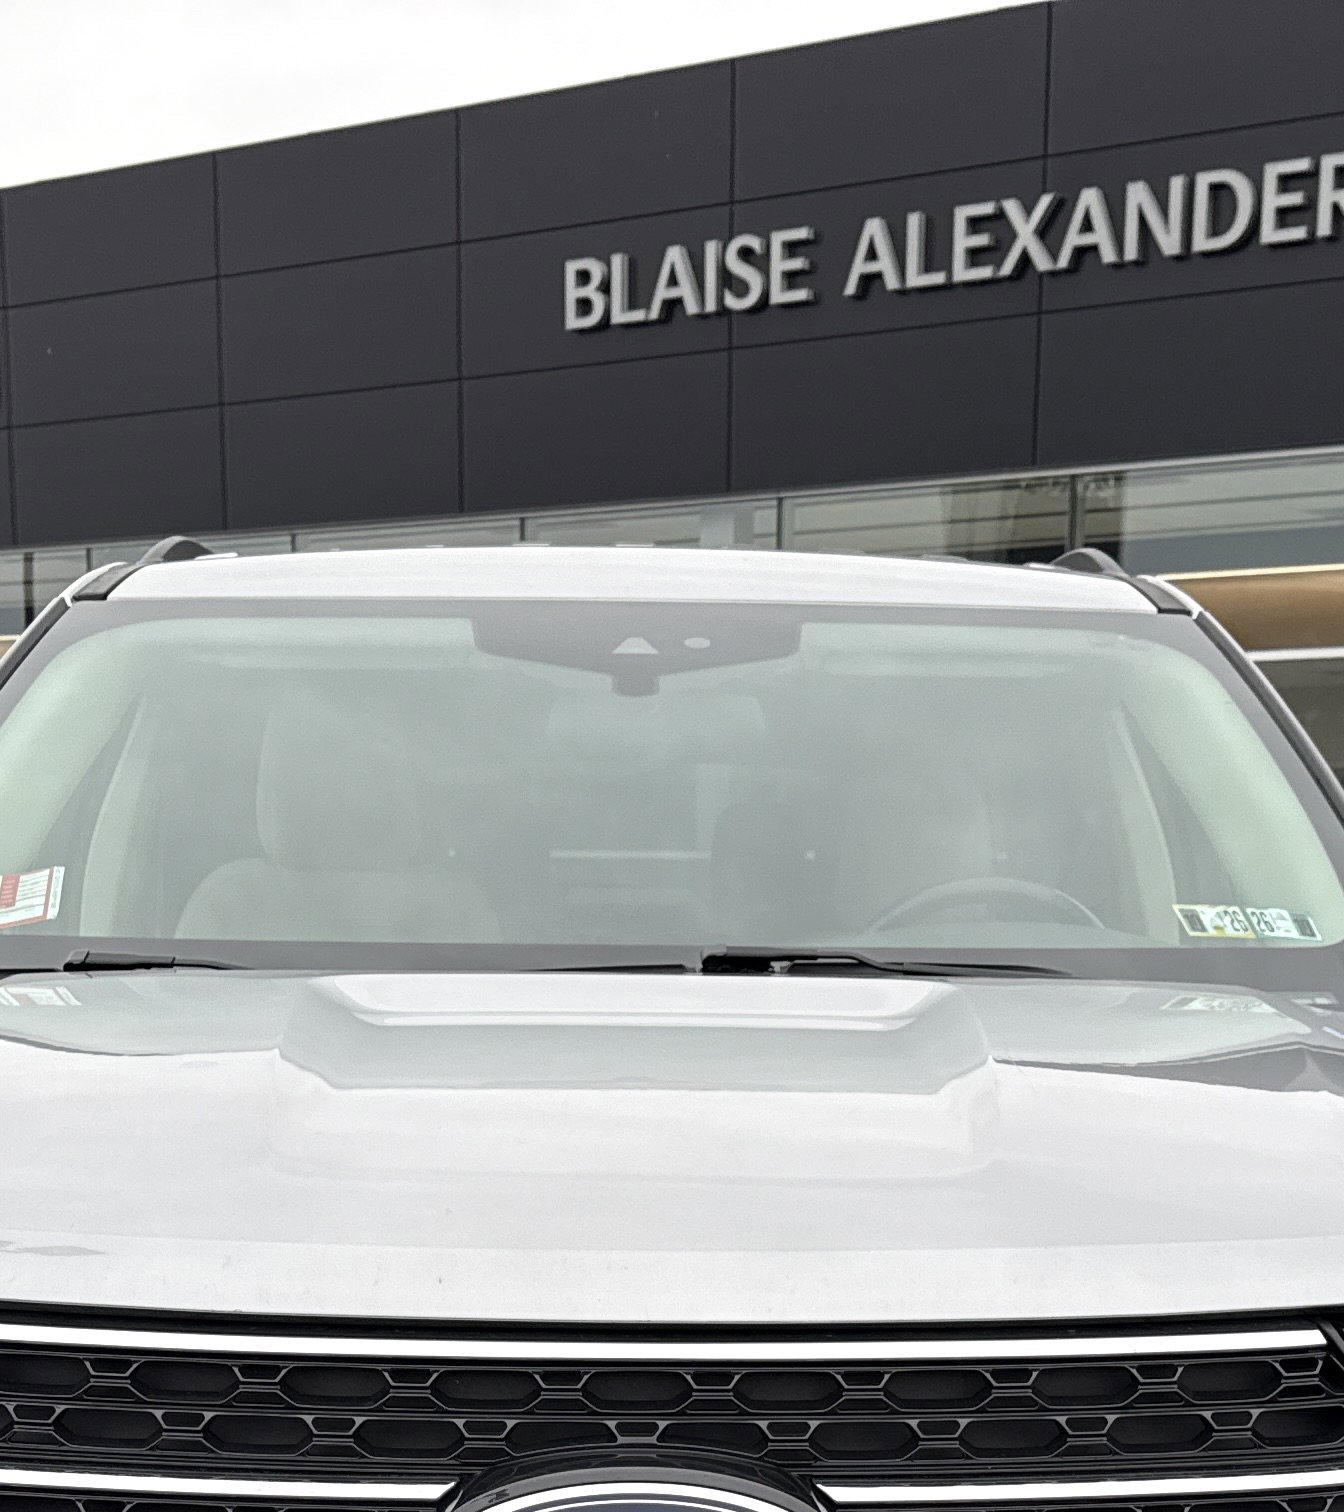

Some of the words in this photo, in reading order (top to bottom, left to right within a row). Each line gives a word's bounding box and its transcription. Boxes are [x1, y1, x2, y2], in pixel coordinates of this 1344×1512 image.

[563, 226, 815, 331] BLAISE
[1223, 909, 1249, 932] 26
[1250, 910, 1275, 933] 26
